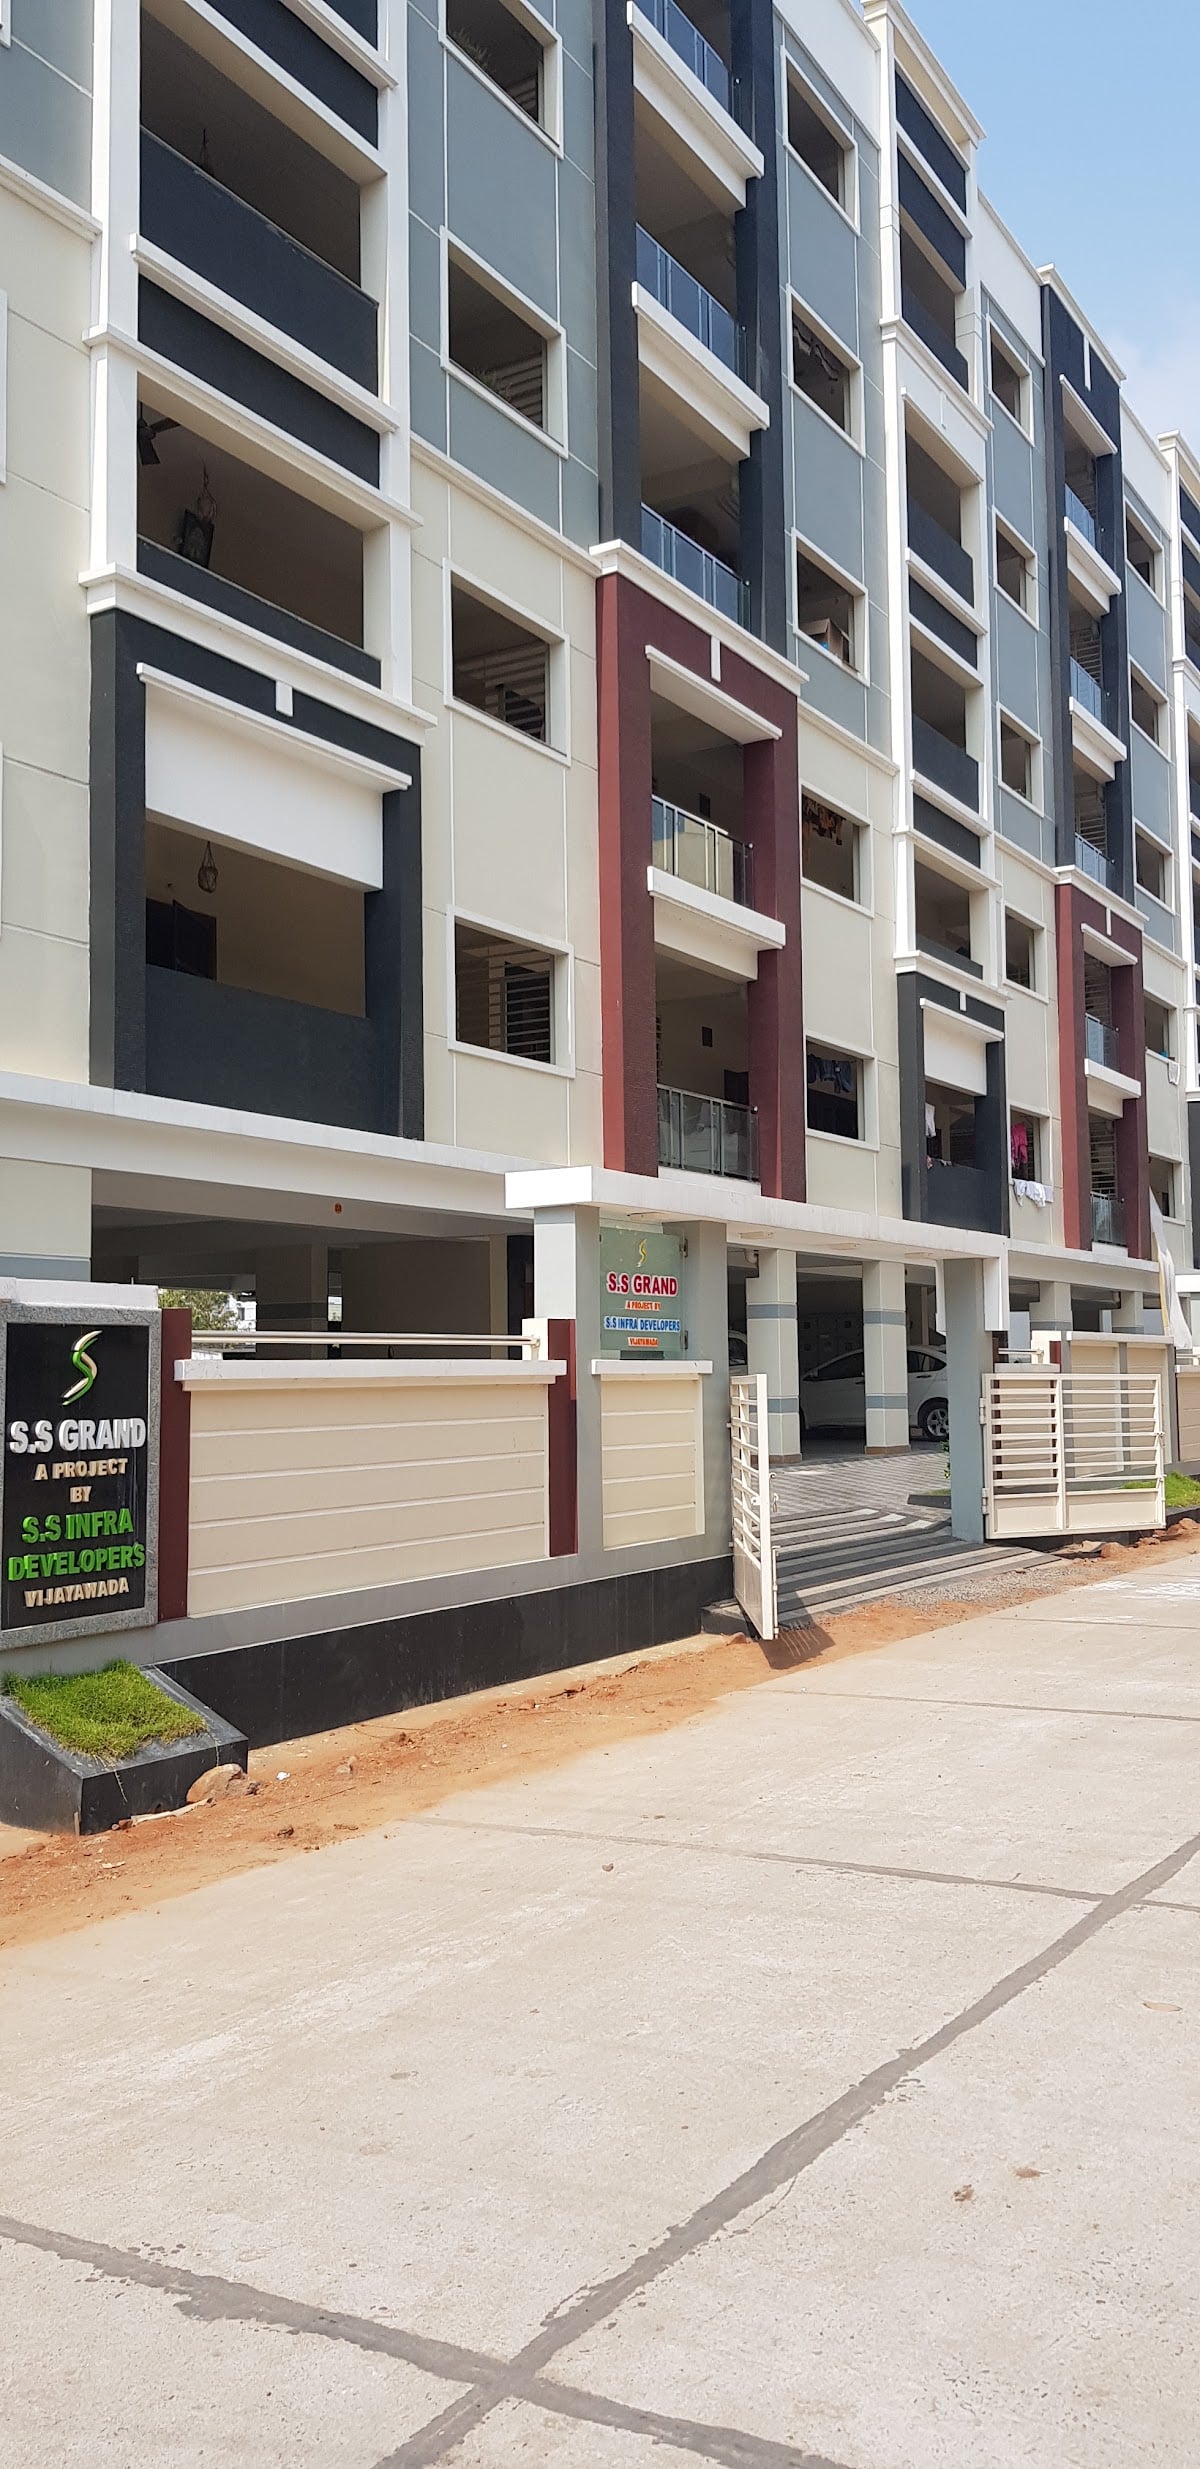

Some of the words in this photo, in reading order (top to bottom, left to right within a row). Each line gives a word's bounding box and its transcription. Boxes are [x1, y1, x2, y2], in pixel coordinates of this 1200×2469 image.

[607, 1272, 629, 1294] S.S
[633, 1274, 678, 1296] GRAND
[626, 1301, 631, 1309] A
[631, 1301, 653, 1310] PROJECT
[605, 1317, 617, 1329] S.S
[617, 1317, 638, 1330] INFRA
[639, 1319, 680, 1332] DEVELOPERS
[9, 1420, 54, 1454] S.S
[58, 1417, 146, 1452] GRAND
[34, 1463, 48, 1480] A
[52, 1458, 128, 1479] PROJECT
[69, 1485, 92, 1503] BY
[21, 1514, 61, 1544] S.S
[65, 1508, 134, 1540] INFRA
[8, 1543, 146, 1581] DEVELOPERS
[24, 1577, 129, 1608] VIJAYAWADA
